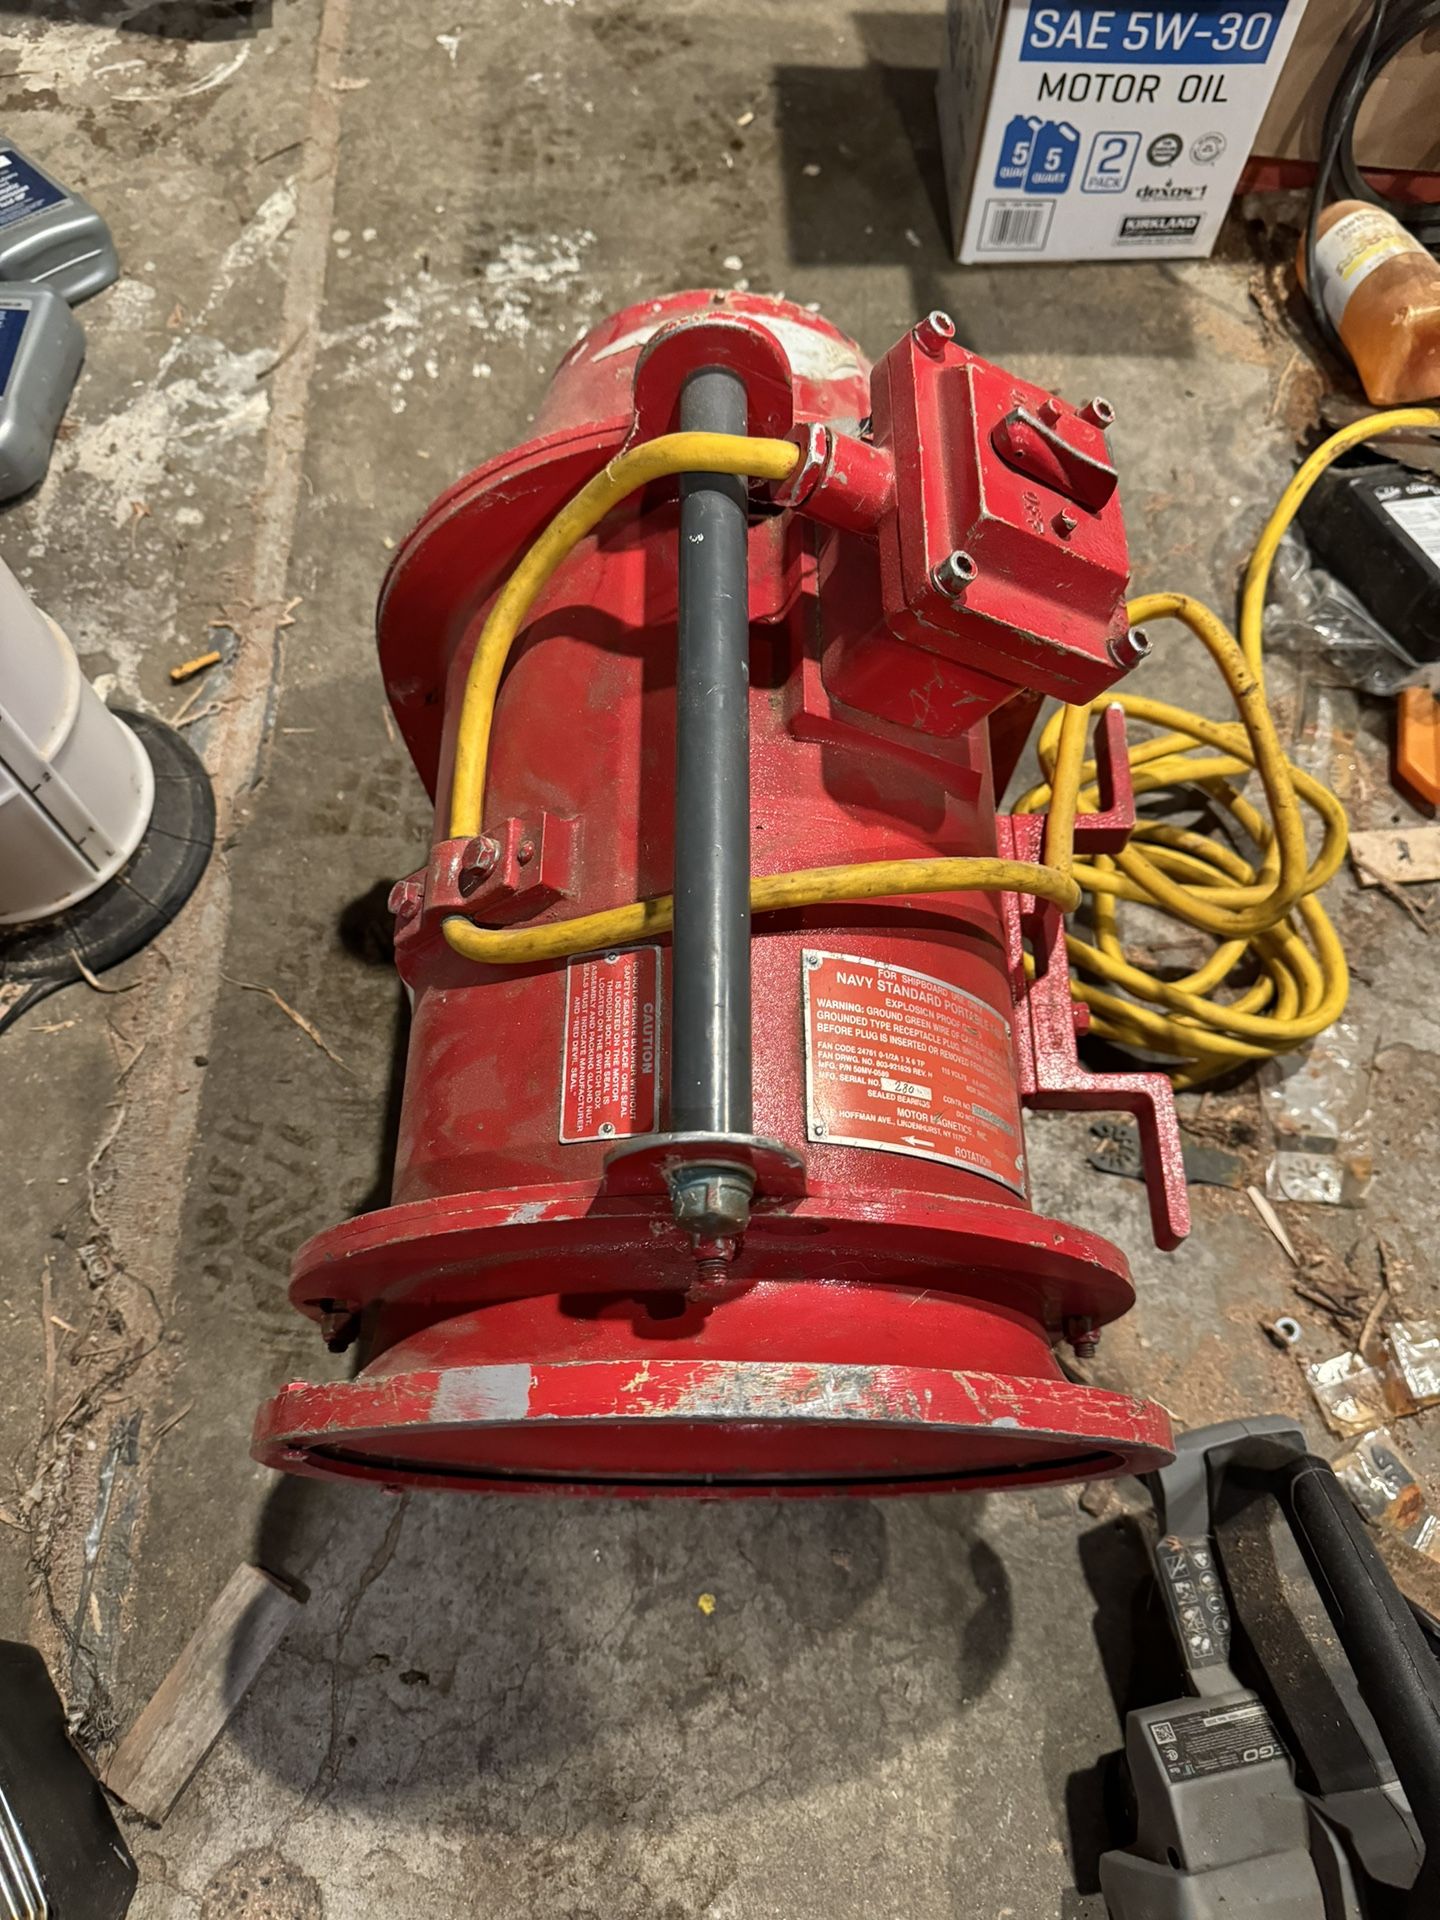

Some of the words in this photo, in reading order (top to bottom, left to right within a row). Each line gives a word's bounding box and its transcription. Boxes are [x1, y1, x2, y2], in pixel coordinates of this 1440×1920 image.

[1029, 9, 1116, 49] SAE
[1122, 11, 1273, 51] 5W-30
[1037, 72, 1161, 103] MOTOR
[1177, 74, 1228, 103] OIL
[1012, 141, 1030, 166] 5
[1044, 147, 1063, 171] 5
[1098, 138, 1128, 175] 2
[1087, 176, 1123, 189] PACK
[1124, 217, 1198, 230] KIRKLAND
[632, 961, 639, 974] DO
[616, 981, 622, 989] IS
[878, 968, 897, 980] FOR
[901, 974, 948, 997] SHIPBOARD
[597, 977, 605, 1016] LOCATED
[836, 971, 874, 989] NAVY
[877, 980, 942, 1008] STANDARD
[944, 999, 989, 1031] PORTABLE
[597, 1018, 603, 1031] ON
[816, 997, 865, 1014] WARNING:
[866, 1006, 904, 1022] GROUND
[905, 1014, 931, 1029] GREEN
[932, 1022, 950, 1036] WIRE
[950, 1029, 960, 1040] OF
[885, 998, 935, 1018] EXPLOSION
[936, 1012, 961, 1028] PROOF
[580, 1016, 588, 1055] INDICATE
[614, 1033, 620, 1045] ON
[623, 1028, 629, 1037] IN
[642, 1003, 653, 1073] CAUTION
[816, 1010, 868, 1026] GROUNDED
[869, 1018, 892, 1031] TYPE
[893, 1023, 941, 1045] RECEPTACLE
[587, 1032, 595, 1070] PACKING
[816, 1022, 854, 1037] BEFORE
[855, 1028, 879, 1041] PLUG
[879, 1033, 888, 1043] IS
[889, 1034, 927, 1052] INSERTED
[928, 1044, 939, 1056] OR
[939, 1048, 970, 1067] REMOVED
[817, 1041, 833, 1051] FAN
[834, 1043, 856, 1054] CODE
[905, 1056, 911, 1064] X
[817, 1050, 833, 1060] FAN
[862, 1057, 875, 1067] NO.
[839, 1063, 852, 1072] P/N
[839, 1073, 866, 1085] SERIAL
[867, 1078, 881, 1087] NO.
[894, 1081, 915, 1094] 280
[577, 1058, 586, 1132] MANUFACTURER
[603, 1096, 610, 1104] IS
[867, 1089, 896, 1101] SEALED
[897, 1094, 931, 1109] BEARINGS
[839, 1110, 877, 1122] HOFFMAN
[896, 1119, 942, 1136] LINDENHURST,
[942, 1129, 952, 1138] NY
[896, 1106, 929, 1122] MOTOR
[954, 1146, 992, 1168] ROTATION
